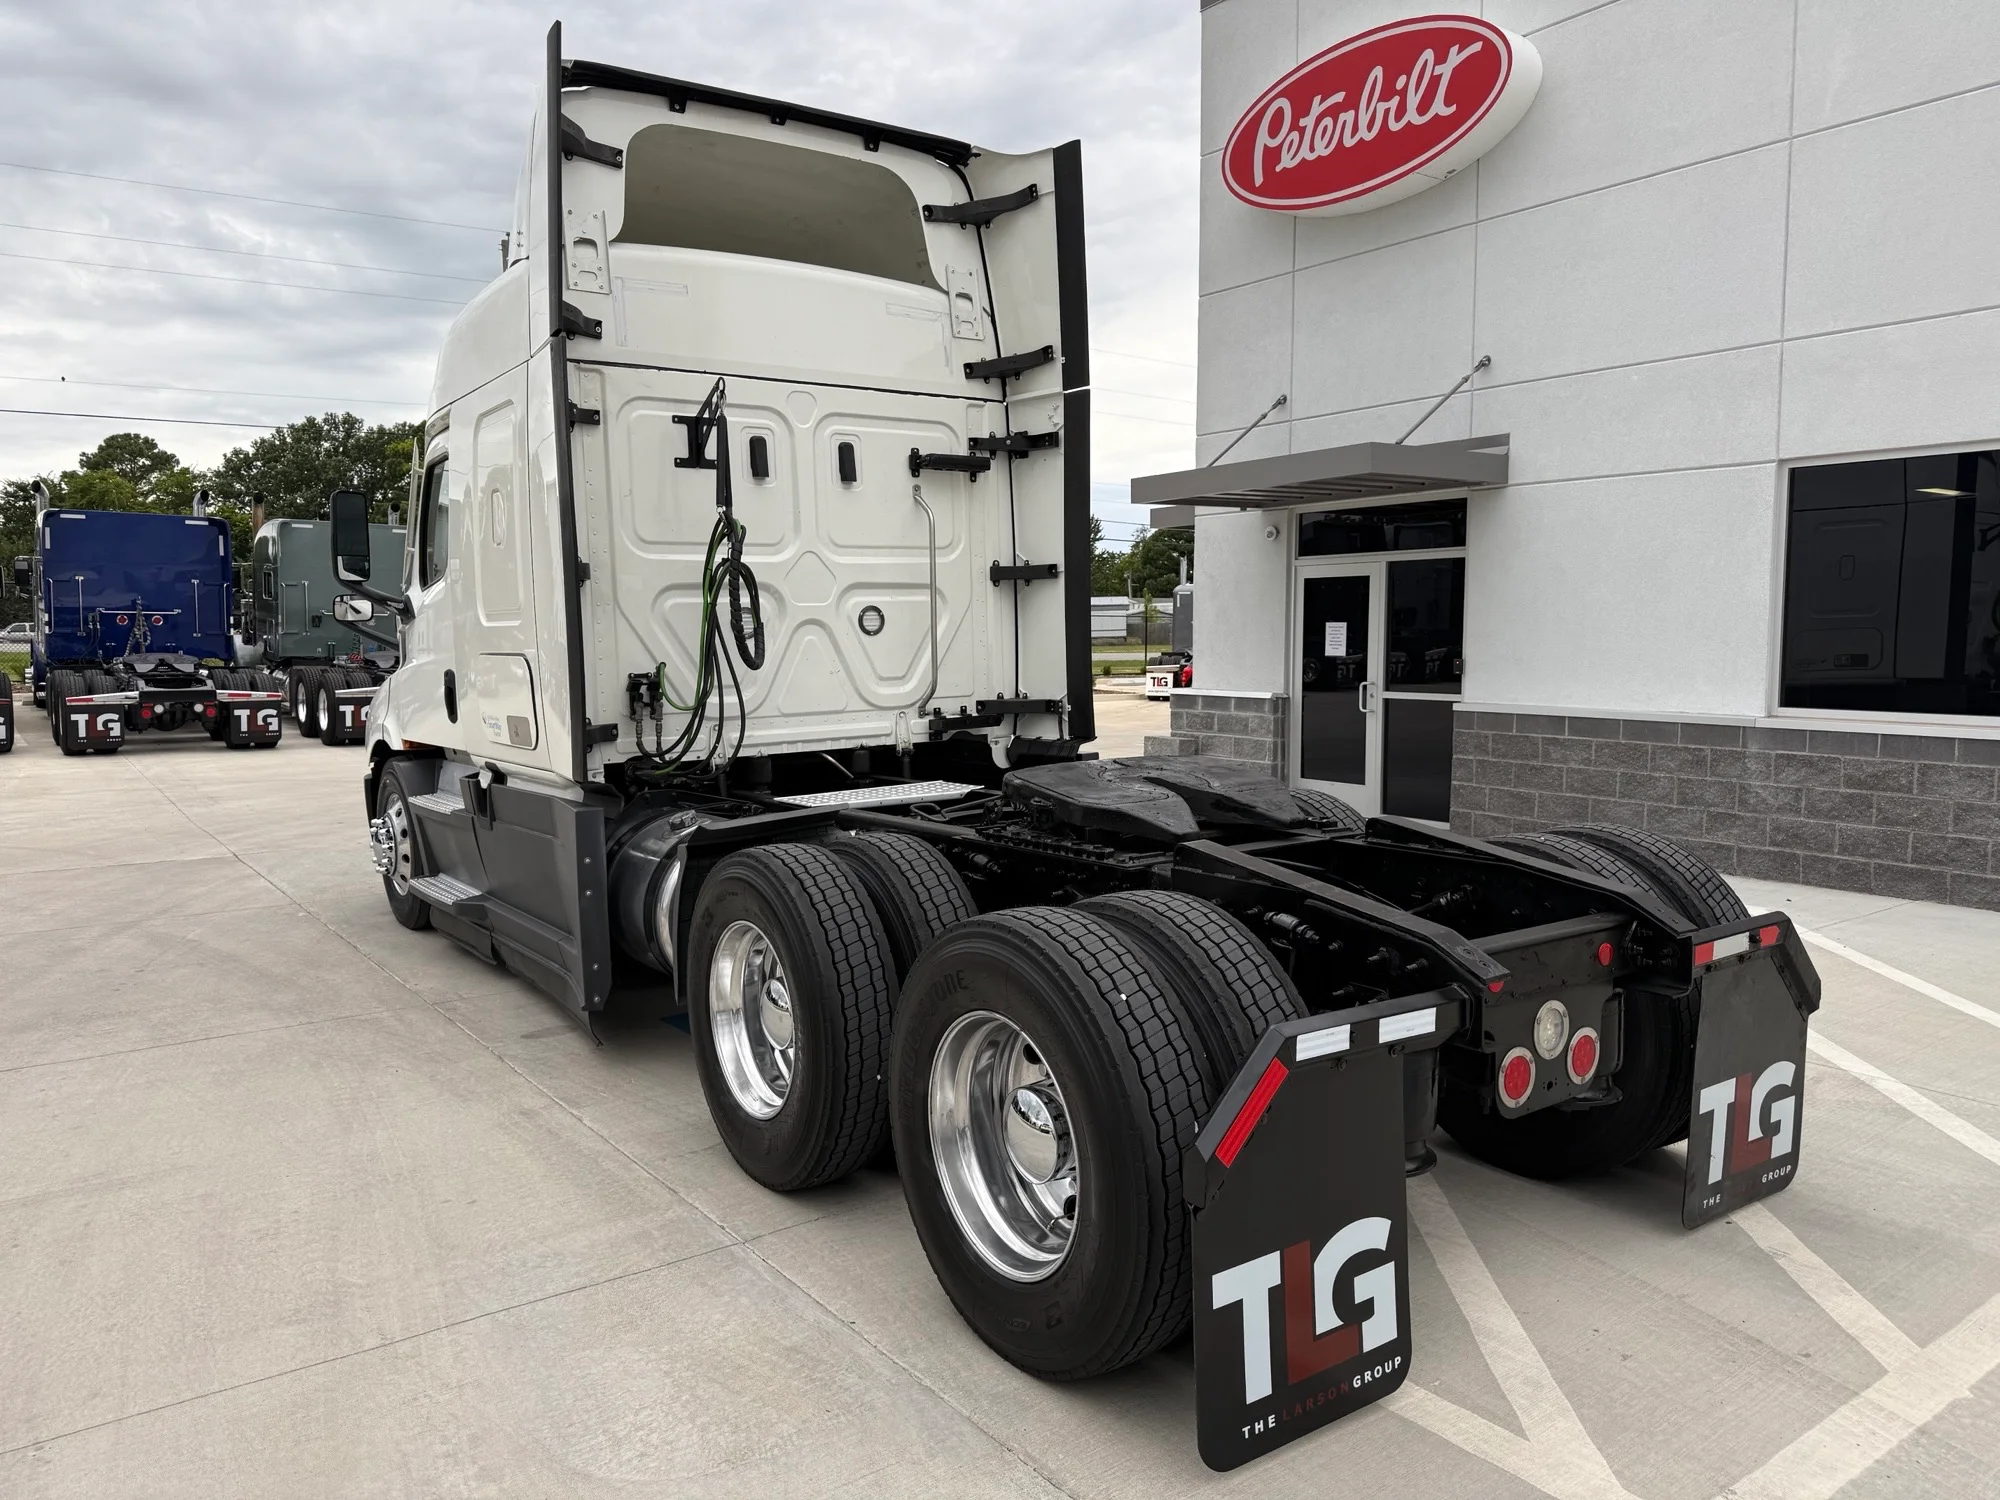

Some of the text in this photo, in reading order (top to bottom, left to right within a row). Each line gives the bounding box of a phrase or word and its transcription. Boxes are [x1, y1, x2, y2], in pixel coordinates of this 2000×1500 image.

[1253, 40, 1484, 187] Peterbilt
[1150, 676, 1168, 687] TLG
[70, 713, 121, 738] TLG
[233, 708, 279, 732] TLG
[1698, 1060, 1797, 1186] TLG
[1702, 1163, 1793, 1210] THE GROUP
[1211, 1216, 1399, 1405] TLG
[1241, 1355, 1403, 1440] THE LARSON GROUP
